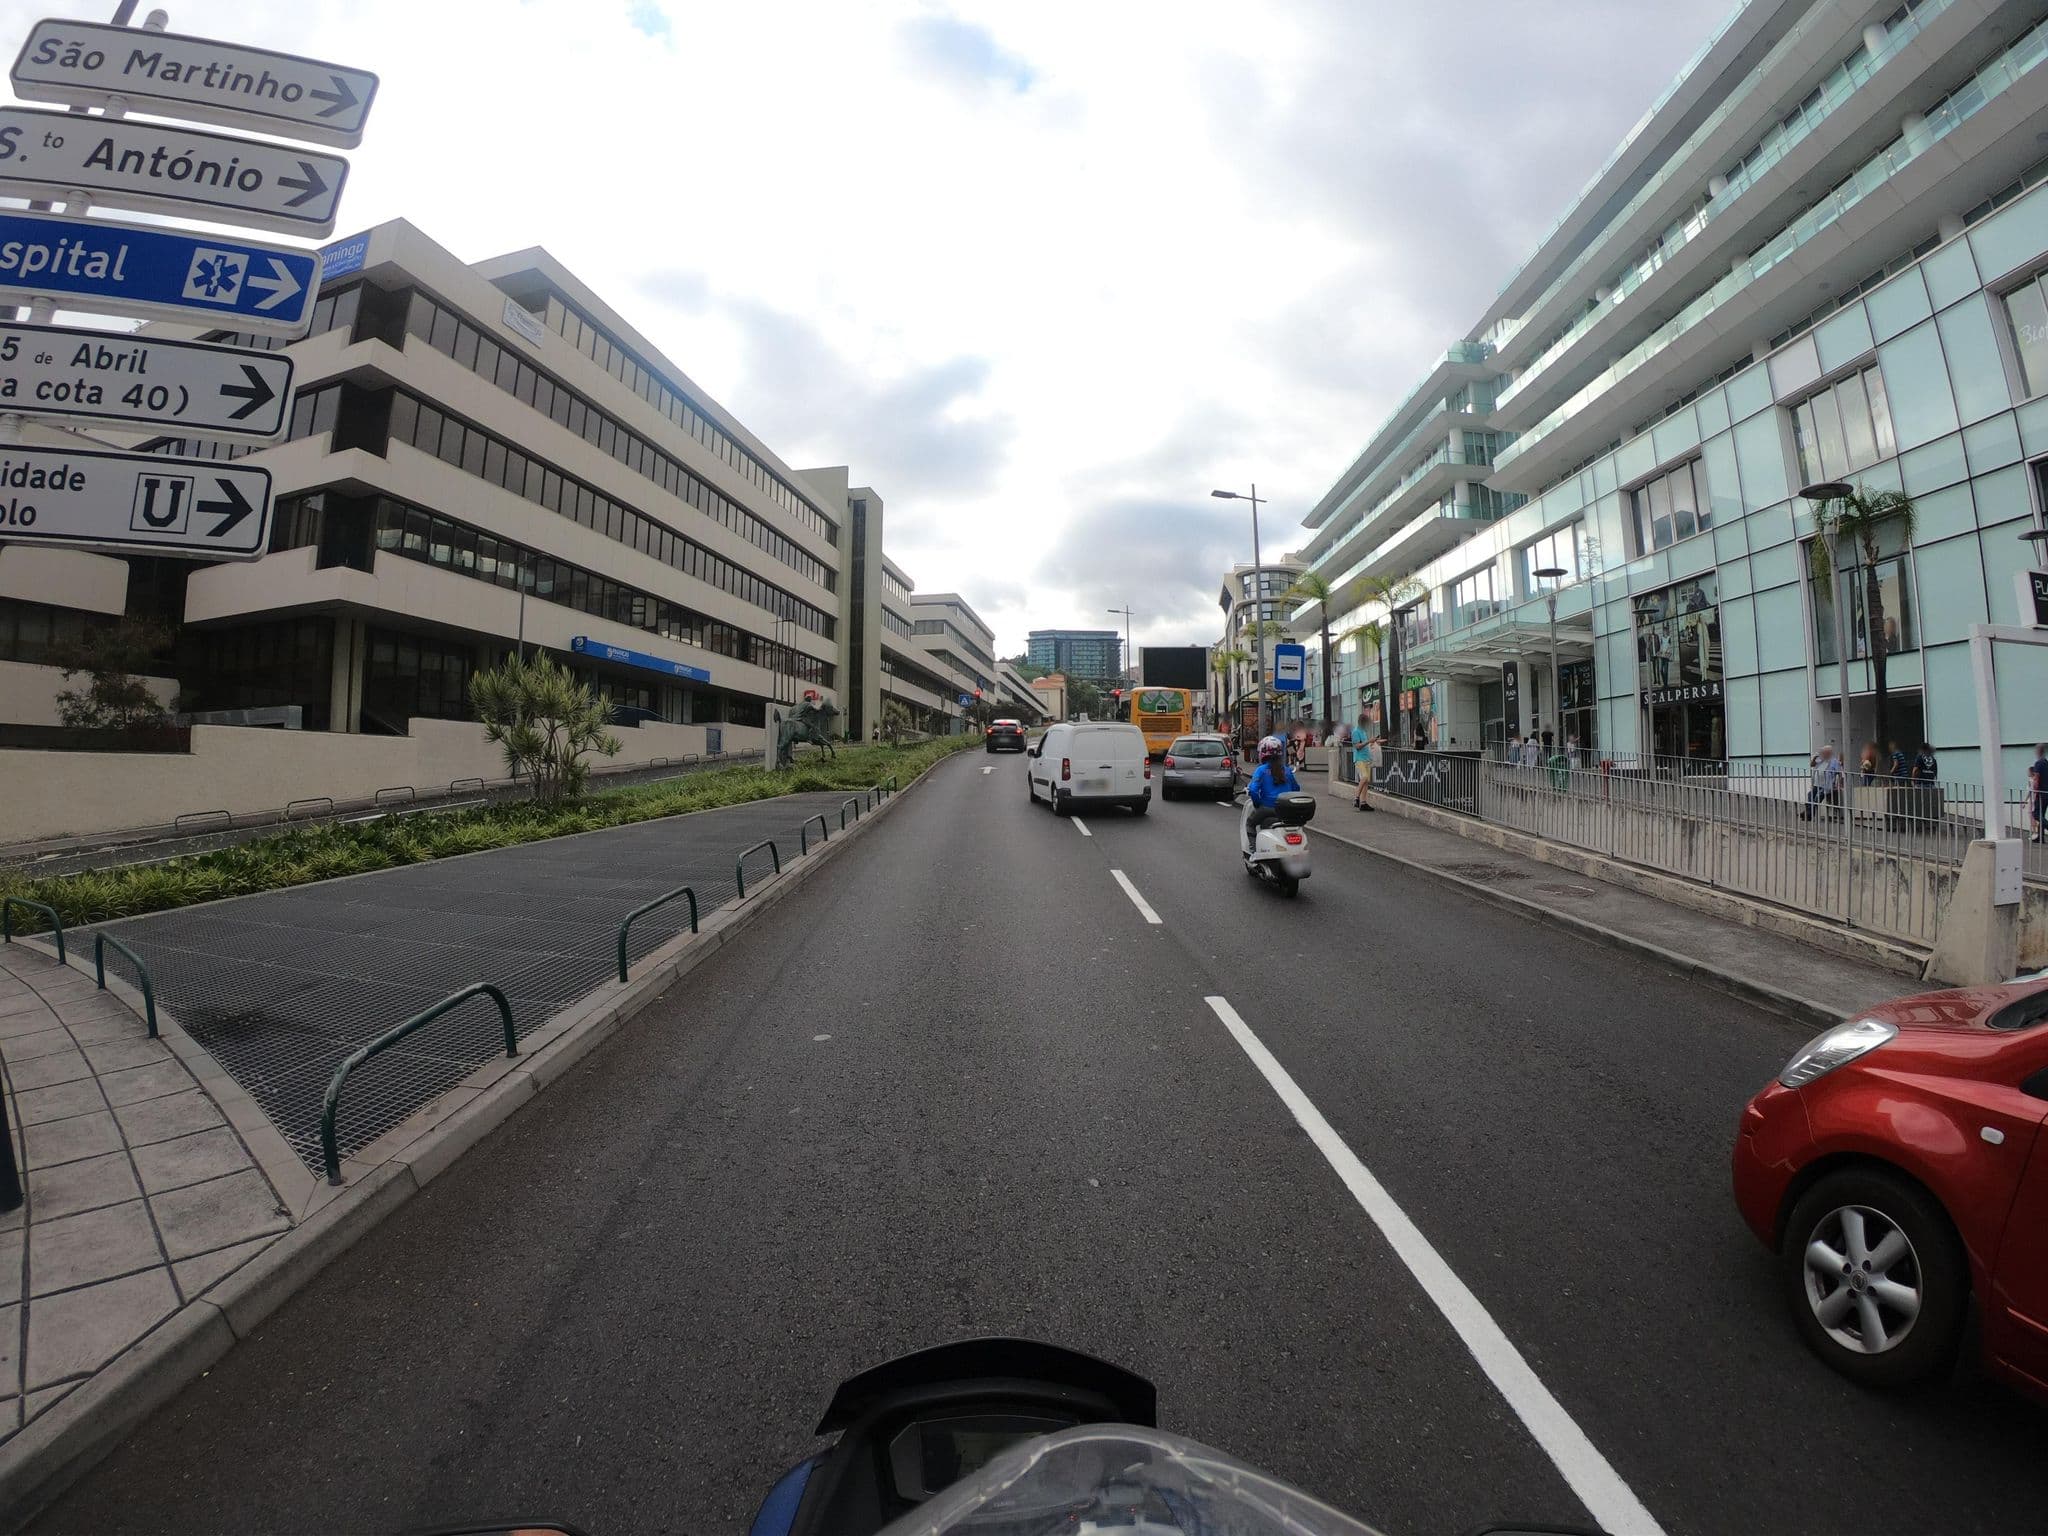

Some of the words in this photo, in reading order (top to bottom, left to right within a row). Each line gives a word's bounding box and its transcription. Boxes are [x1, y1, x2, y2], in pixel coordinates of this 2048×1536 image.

[31, 38, 105, 70] São
[122, 49, 304, 103] Martinho
[43, 131, 65, 149] to
[83, 138, 264, 192] António
[0, 238, 128, 281] spital
[1, 336, 21, 361] 5
[34, 352, 53, 365] de
[70, 343, 149, 374] Abril
[36, 378, 104, 405] cota
[121, 384, 190, 416] 40)
[0, 460, 86, 492] idade
[1643, 685, 1707, 705] SCALPERS
[1355, 758, 1441, 783] LAZA
